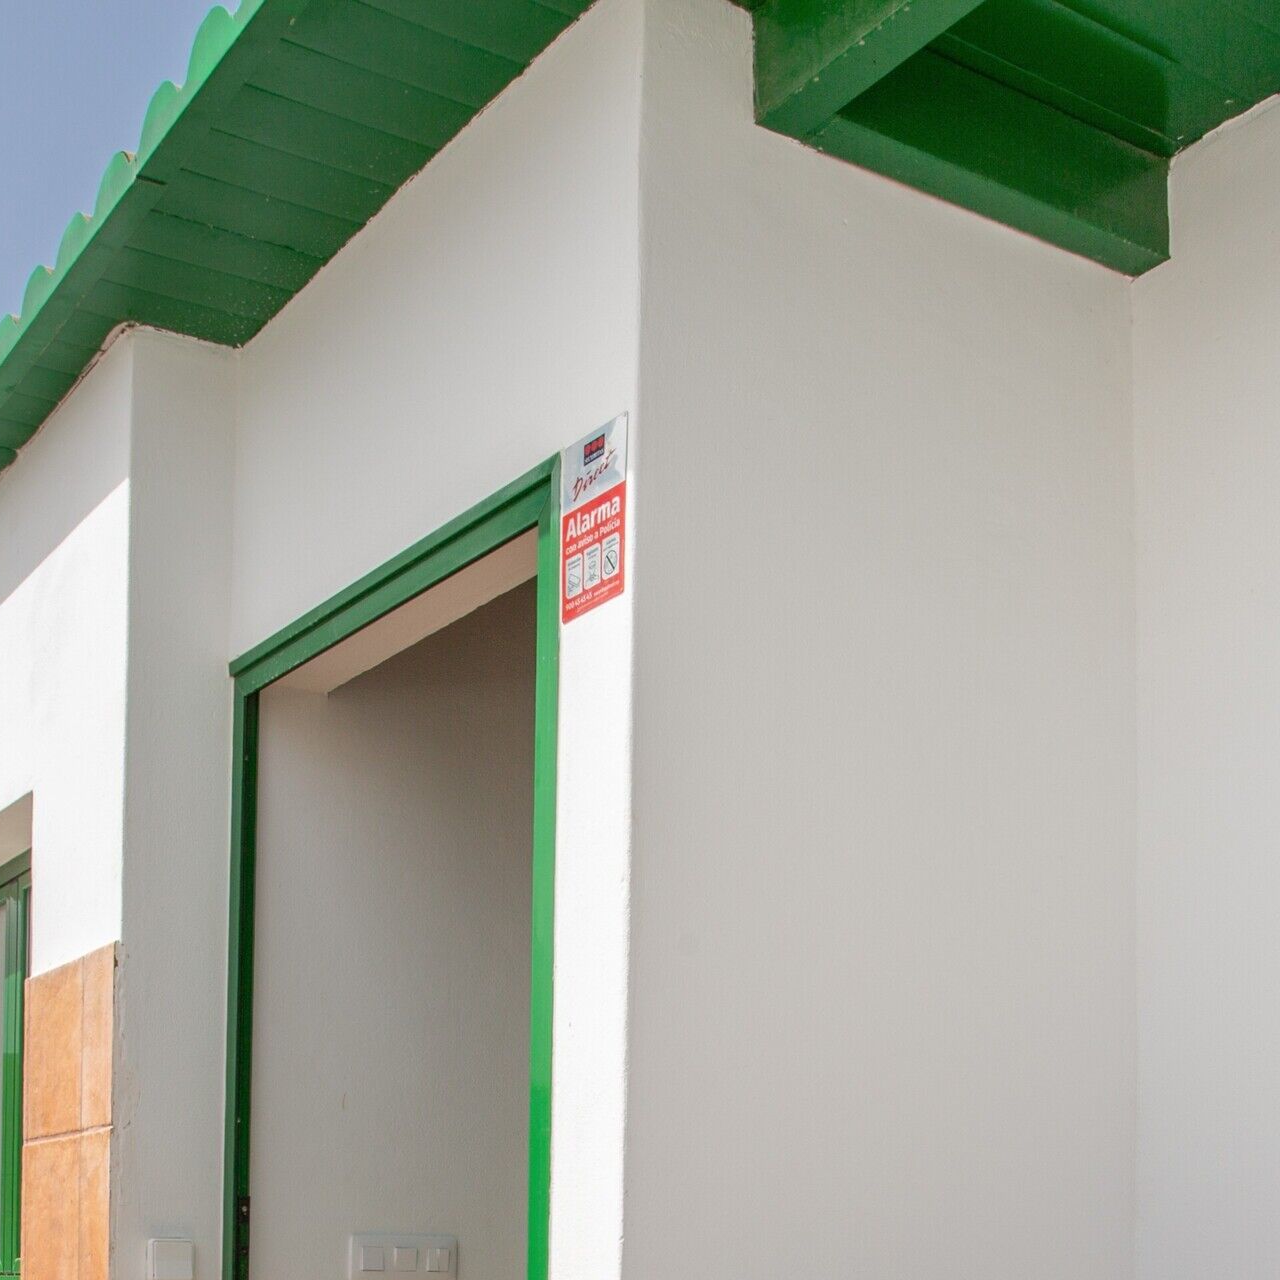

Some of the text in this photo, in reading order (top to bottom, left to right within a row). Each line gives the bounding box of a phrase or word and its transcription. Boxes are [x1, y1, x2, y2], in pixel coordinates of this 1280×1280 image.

[566, 496, 620, 542] Alarma
[566, 543, 577, 555] con
[577, 534, 594, 548] aviso
[594, 531, 599, 539] a
